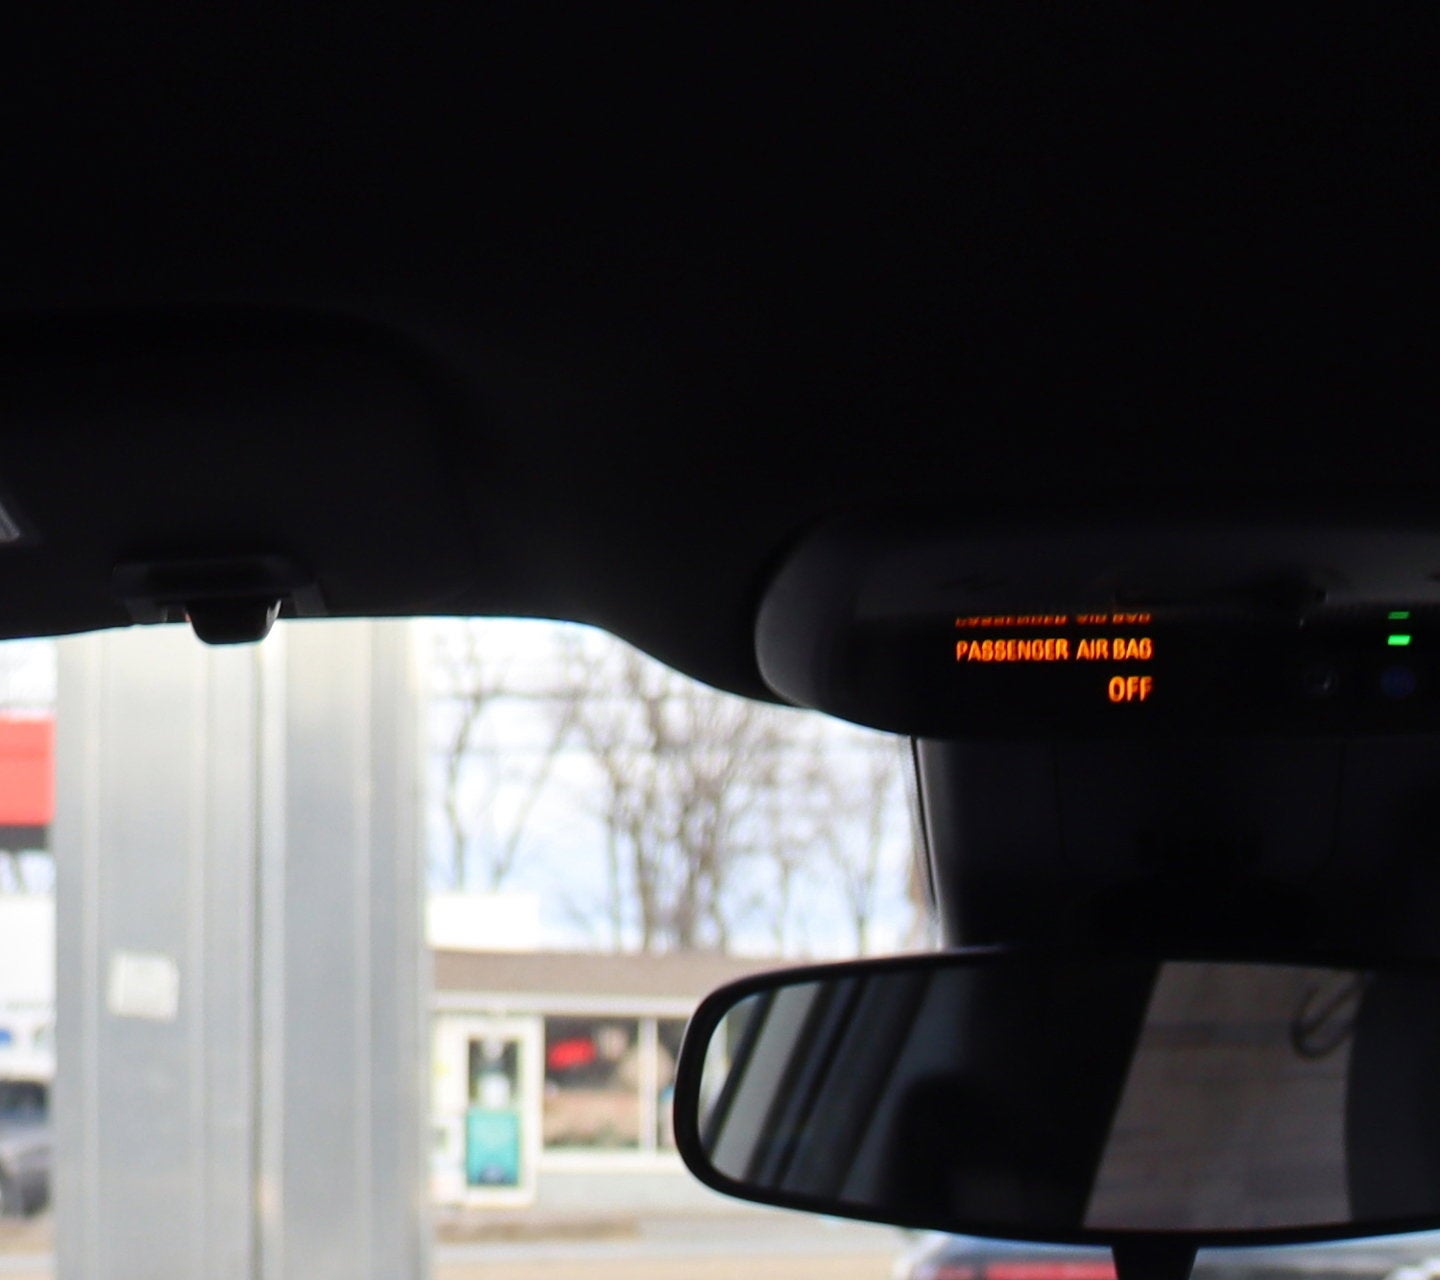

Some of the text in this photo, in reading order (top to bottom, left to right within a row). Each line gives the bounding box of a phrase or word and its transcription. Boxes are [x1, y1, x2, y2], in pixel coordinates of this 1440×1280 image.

[956, 637, 1153, 662] PASSENGER AIR BAG
[1108, 676, 1154, 702] OFF
